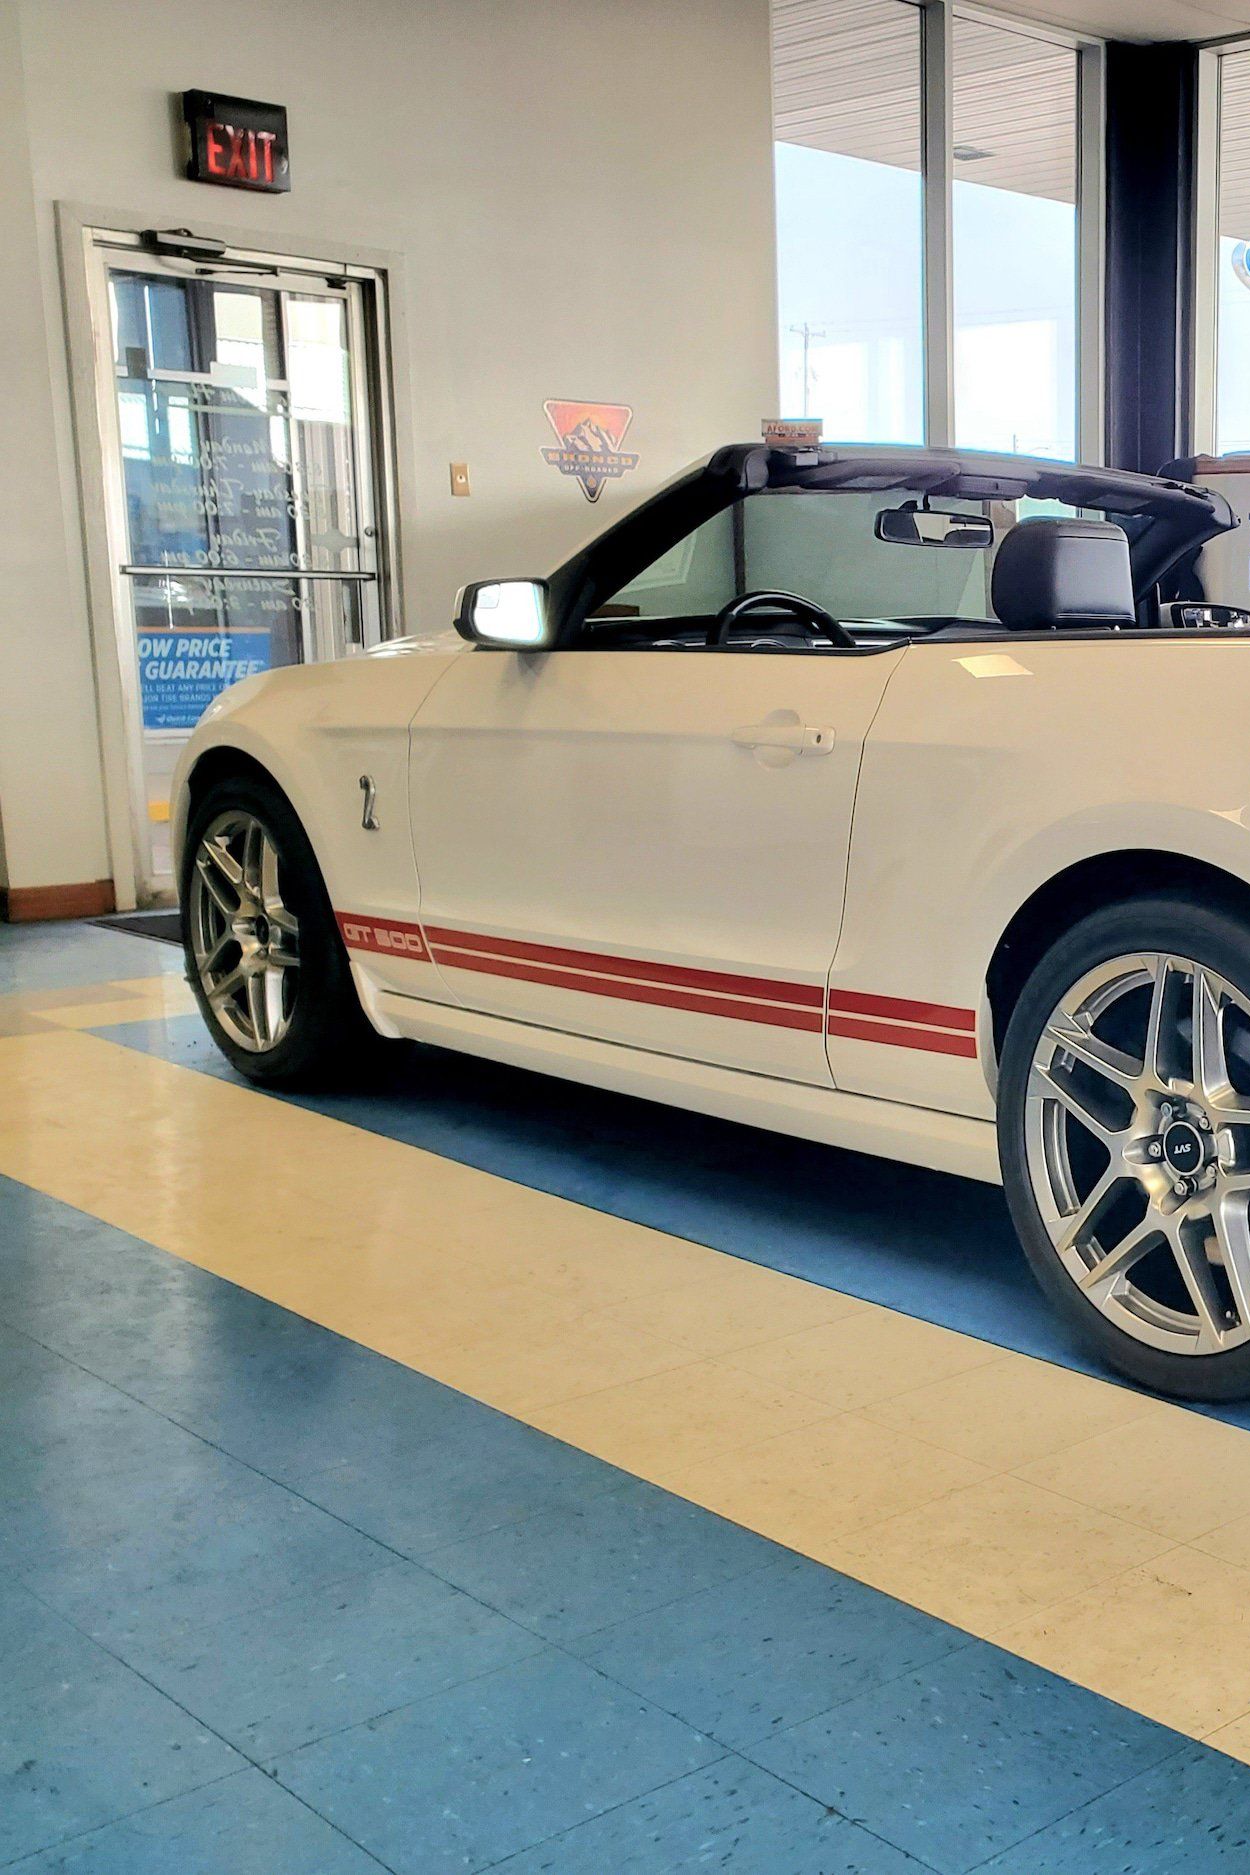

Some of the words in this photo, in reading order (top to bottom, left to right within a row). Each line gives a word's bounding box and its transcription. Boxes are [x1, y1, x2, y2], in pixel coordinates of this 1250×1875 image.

[207, 121, 276, 184] EXIT
[547, 451, 633, 465] BRONCO
[138, 638, 173, 658] OW
[175, 638, 233, 658] PRICE
[343, 923, 372, 943] GT
[373, 928, 423, 953] 500
[1174, 1143, 1192, 1155] SVT
